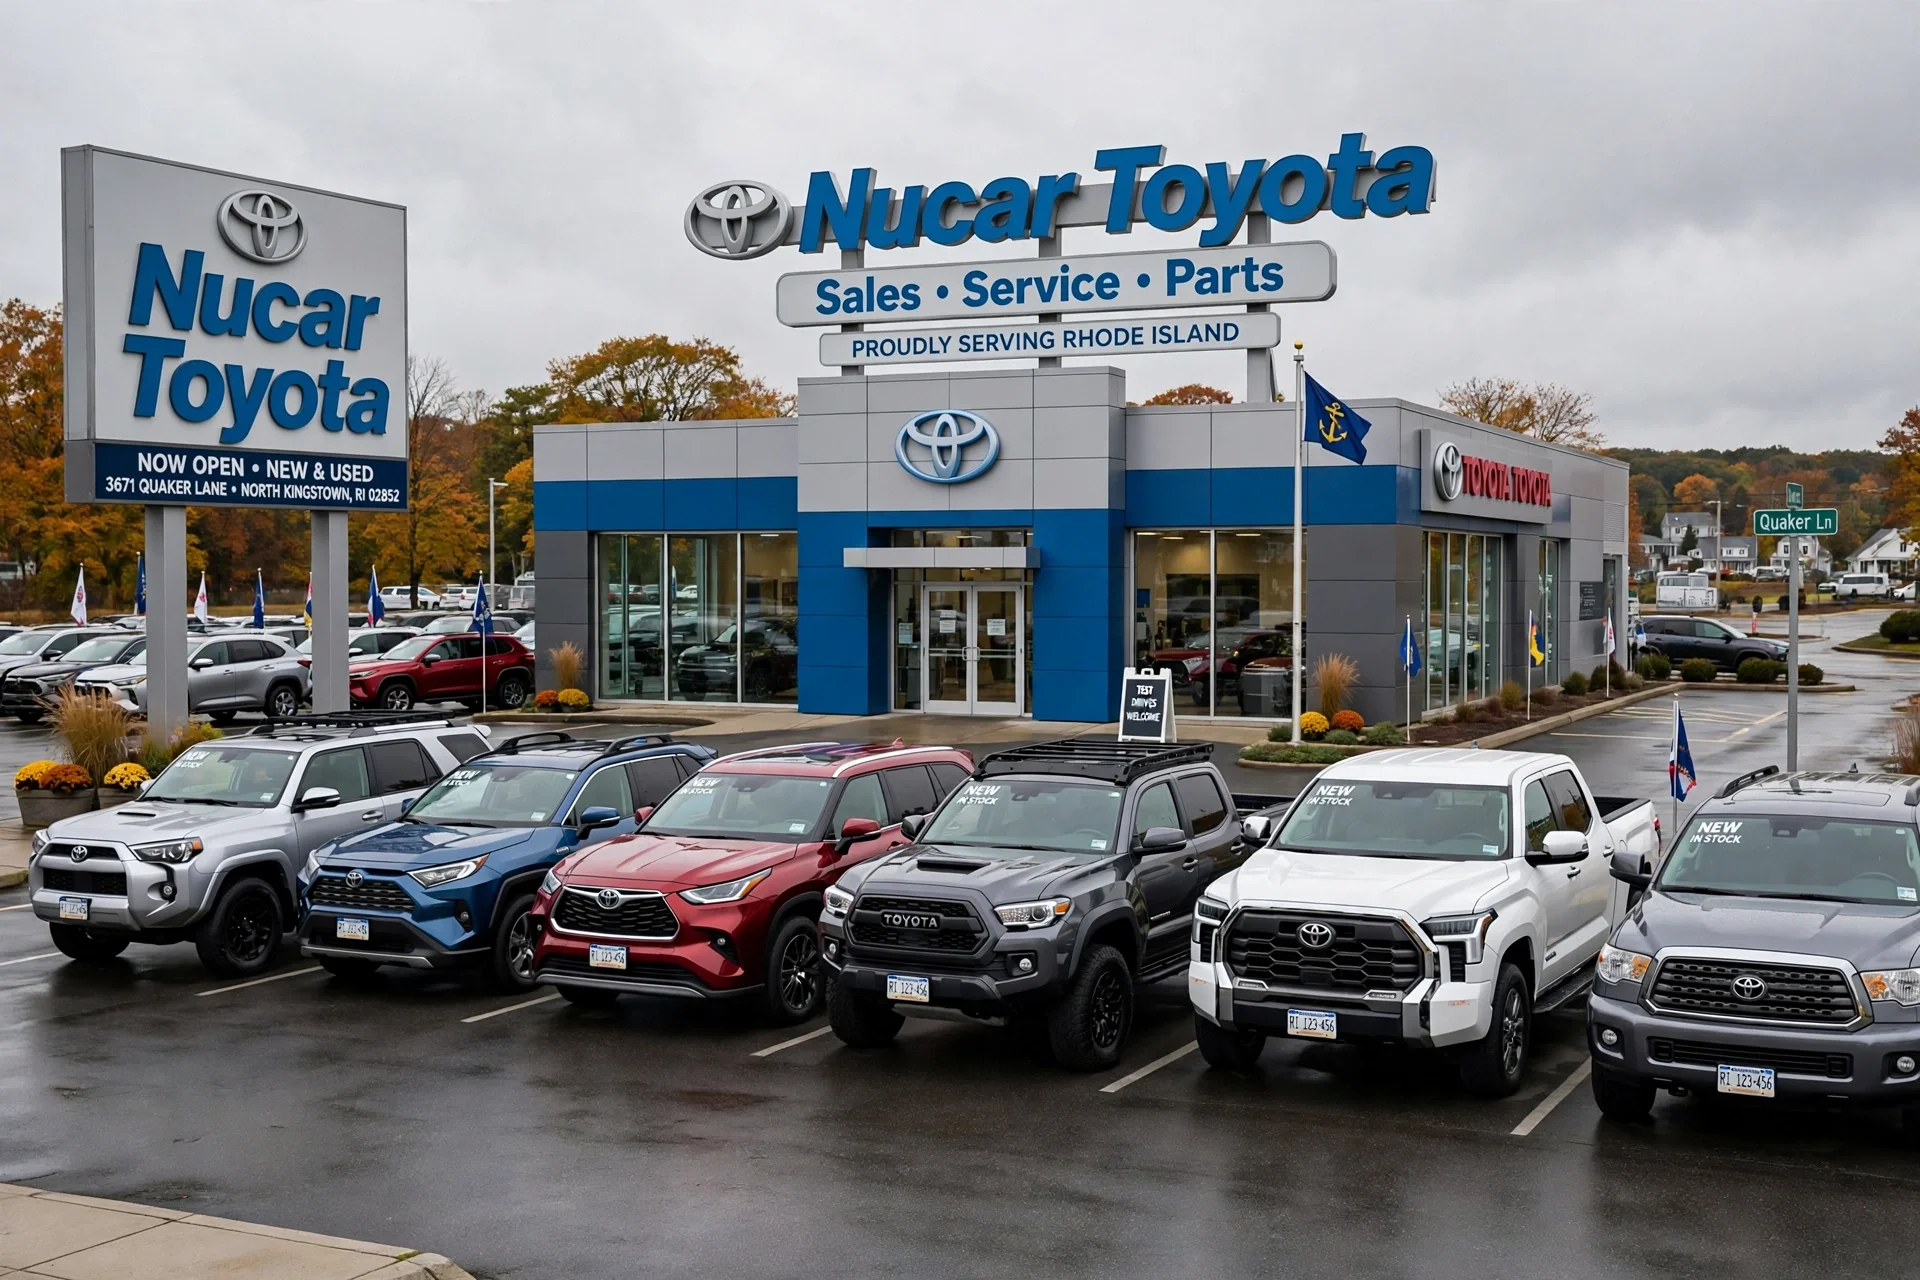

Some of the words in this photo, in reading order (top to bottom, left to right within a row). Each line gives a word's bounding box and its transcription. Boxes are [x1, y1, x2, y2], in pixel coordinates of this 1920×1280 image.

[799, 167, 1080, 254] Nucar
[1095, 132, 1437, 247] Toyota
[815, 276, 922, 316] Sales
[962, 264, 1121, 307] Service
[1166, 257, 1284, 296] Parts
[128, 242, 381, 351] Nucar
[851, 335, 952, 359] PROUDLY
[958, 331, 1056, 353] SERVING
[1063, 326, 1145, 349] RHODE
[1151, 322, 1240, 345] ISLAND
[122, 333, 390, 445] Toyota
[138, 452, 187, 474] NOW
[192, 455, 245, 477] OPEN
[266, 459, 309, 480] NEW
[313, 462, 326, 481] &
[330, 463, 374, 483] USED
[105, 476, 136, 493] 3671
[139, 478, 192, 496] QUAKER
[195, 480, 228, 496] LANE
[241, 482, 281, 498] NORTH
[283, 484, 353, 503] KINGSTOWN,
[355, 488, 366, 501] RI
[368, 489, 400, 503] 02852
[1461, 455, 1510, 501] TOYOTA
[1511, 466, 1552, 507] TOYOTA
[1760, 513, 1811, 531] Quaker
[1816, 513, 1832, 530] Ln
[1136, 685, 1154, 695] TEST
[963, 785, 1001, 796] NEW
[1316, 785, 1356, 796] NEW
[1306, 797, 1320, 805] IN
[1318, 797, 1353, 806] STOCK
[1697, 821, 1743, 833] NEW
[1690, 834, 1703, 843] IN
[1703, 834, 1742, 844] STOCK
[884, 914, 938, 928] TOYOTA
[1303, 1017, 1335, 1033] 123-456
[1736, 1073, 1773, 1090] 123-456
